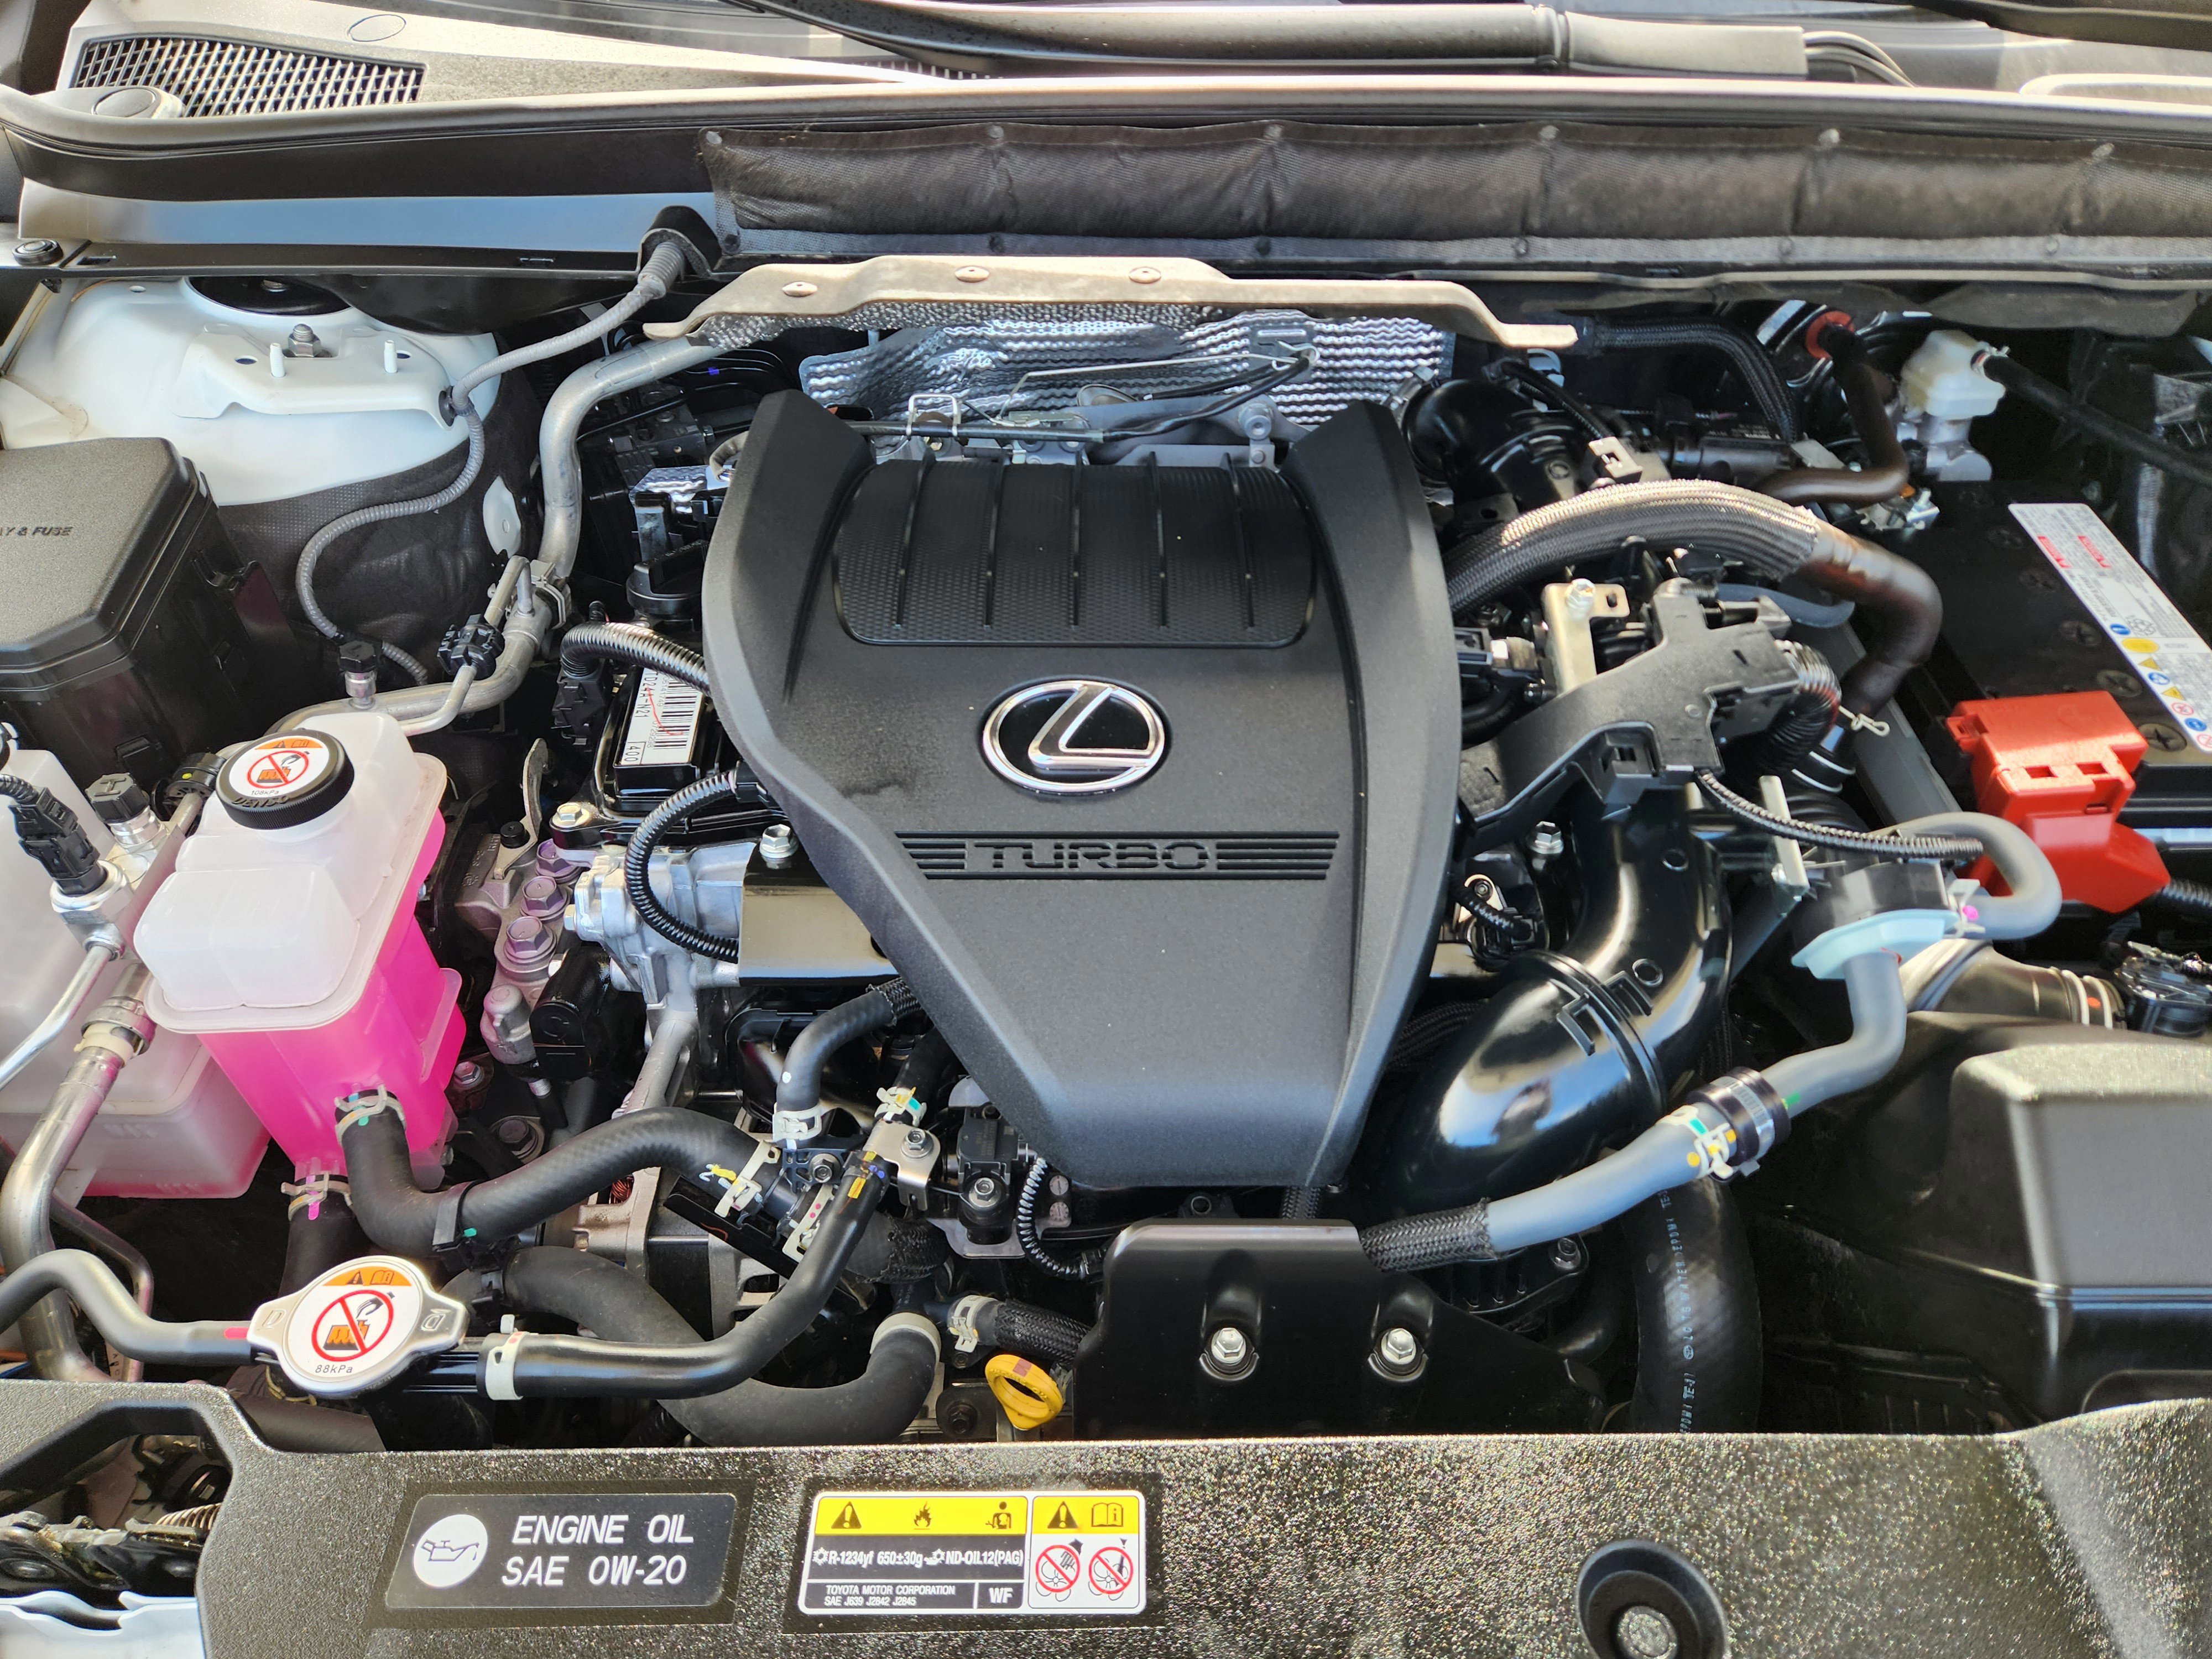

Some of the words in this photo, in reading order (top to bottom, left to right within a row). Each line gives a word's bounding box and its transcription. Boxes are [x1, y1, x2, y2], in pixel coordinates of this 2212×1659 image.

[32, 526, 74, 536] FUSE
[624, 745, 640, 762] 400
[973, 841, 1210, 869] TURBO
[315, 1364, 353, 1374] 88kPa
[512, 1515, 629, 1544] ENGINE
[647, 1514, 694, 1544] OIL
[828, 1551, 873, 1568] R-1234yf
[877, 1551, 923, 1568] 650±30g
[502, 1556, 570, 1587] SAE
[588, 1554, 687, 1586] 0W-20
[826, 1585, 859, 1595] TOYOTA
[862, 1585, 893, 1595] MOTOR
[896, 1585, 956, 1595] CORPORATION
[989, 1588, 1014, 1604] WF
[824, 1597, 842, 1606] SAE
[844, 1597, 863, 1606] J639
[866, 1597, 890, 1606] J2842
[893, 1596, 917, 1606] J2845
